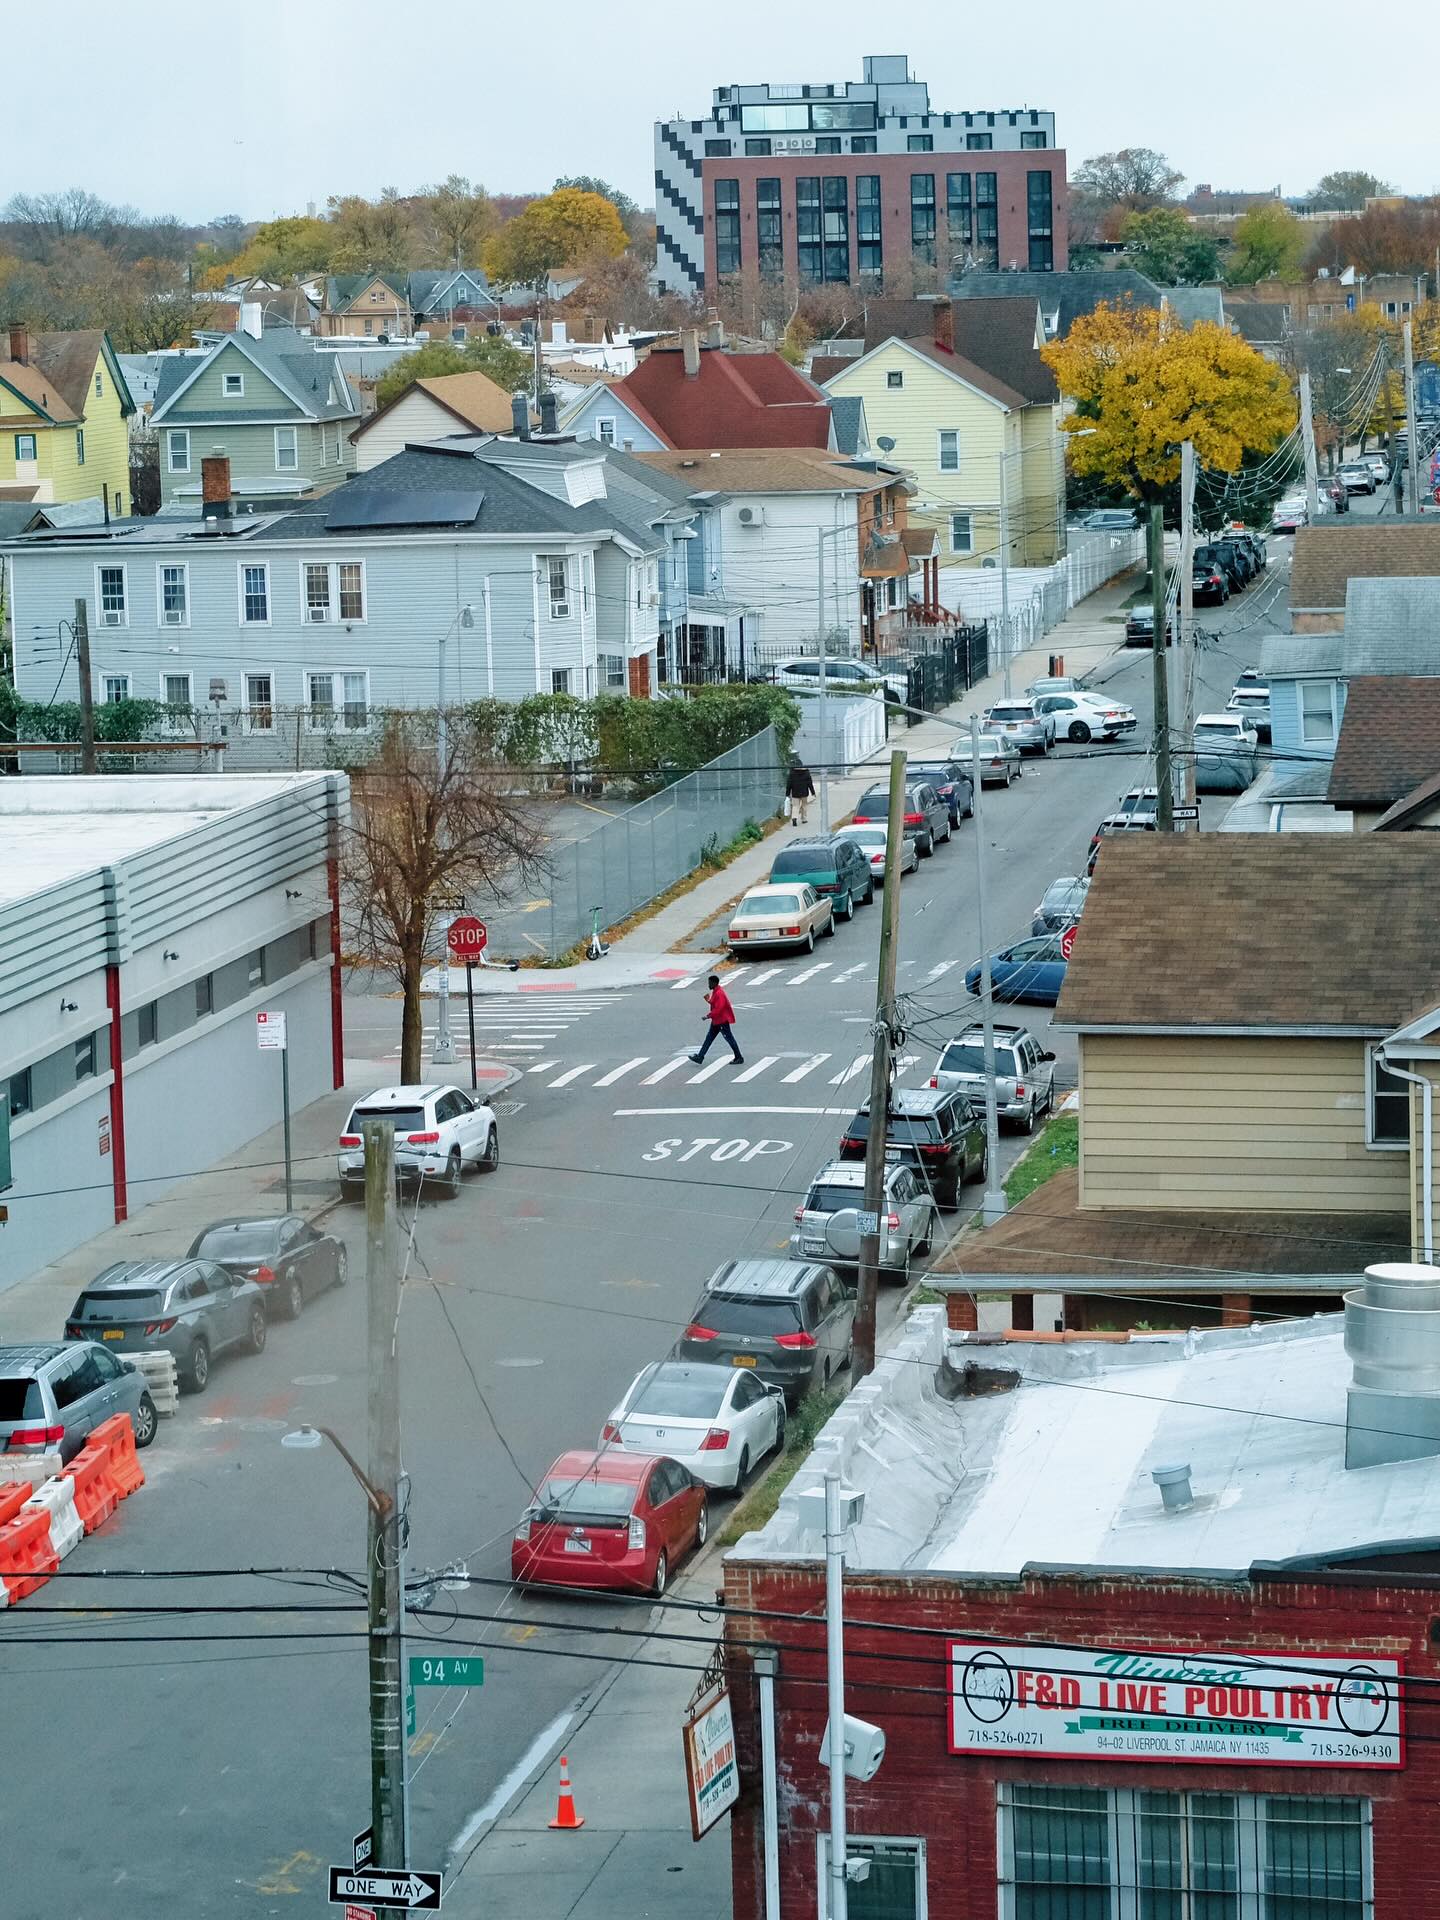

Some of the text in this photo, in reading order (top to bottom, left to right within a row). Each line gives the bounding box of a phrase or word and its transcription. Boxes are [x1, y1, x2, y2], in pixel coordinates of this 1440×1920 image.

[449, 928, 485, 945] STOP
[641, 1138, 794, 1162] STOP
[422, 1660, 445, 1681] 94
[1094, 1653, 1248, 1683] Vivero
[1017, 1671, 1334, 1721] F&D LIVE POULTRY
[1099, 1718, 1270, 1736] FREE DELIVERY
[967, 1729, 1044, 1745] 718-526-0271
[1126, 1737, 1171, 1751] LIVERPOOL
[1174, 1738, 1186, 1752] ST.
[1190, 1739, 1227, 1753] JAMAICA
[1229, 1741, 1242, 1753] NY
[1245, 1741, 1270, 1755] 11435
[1310, 1743, 1393, 1758] 718-526-9430
[357, 1841, 370, 1861] ONE
[345, 1879, 424, 1897] ONE WAY
